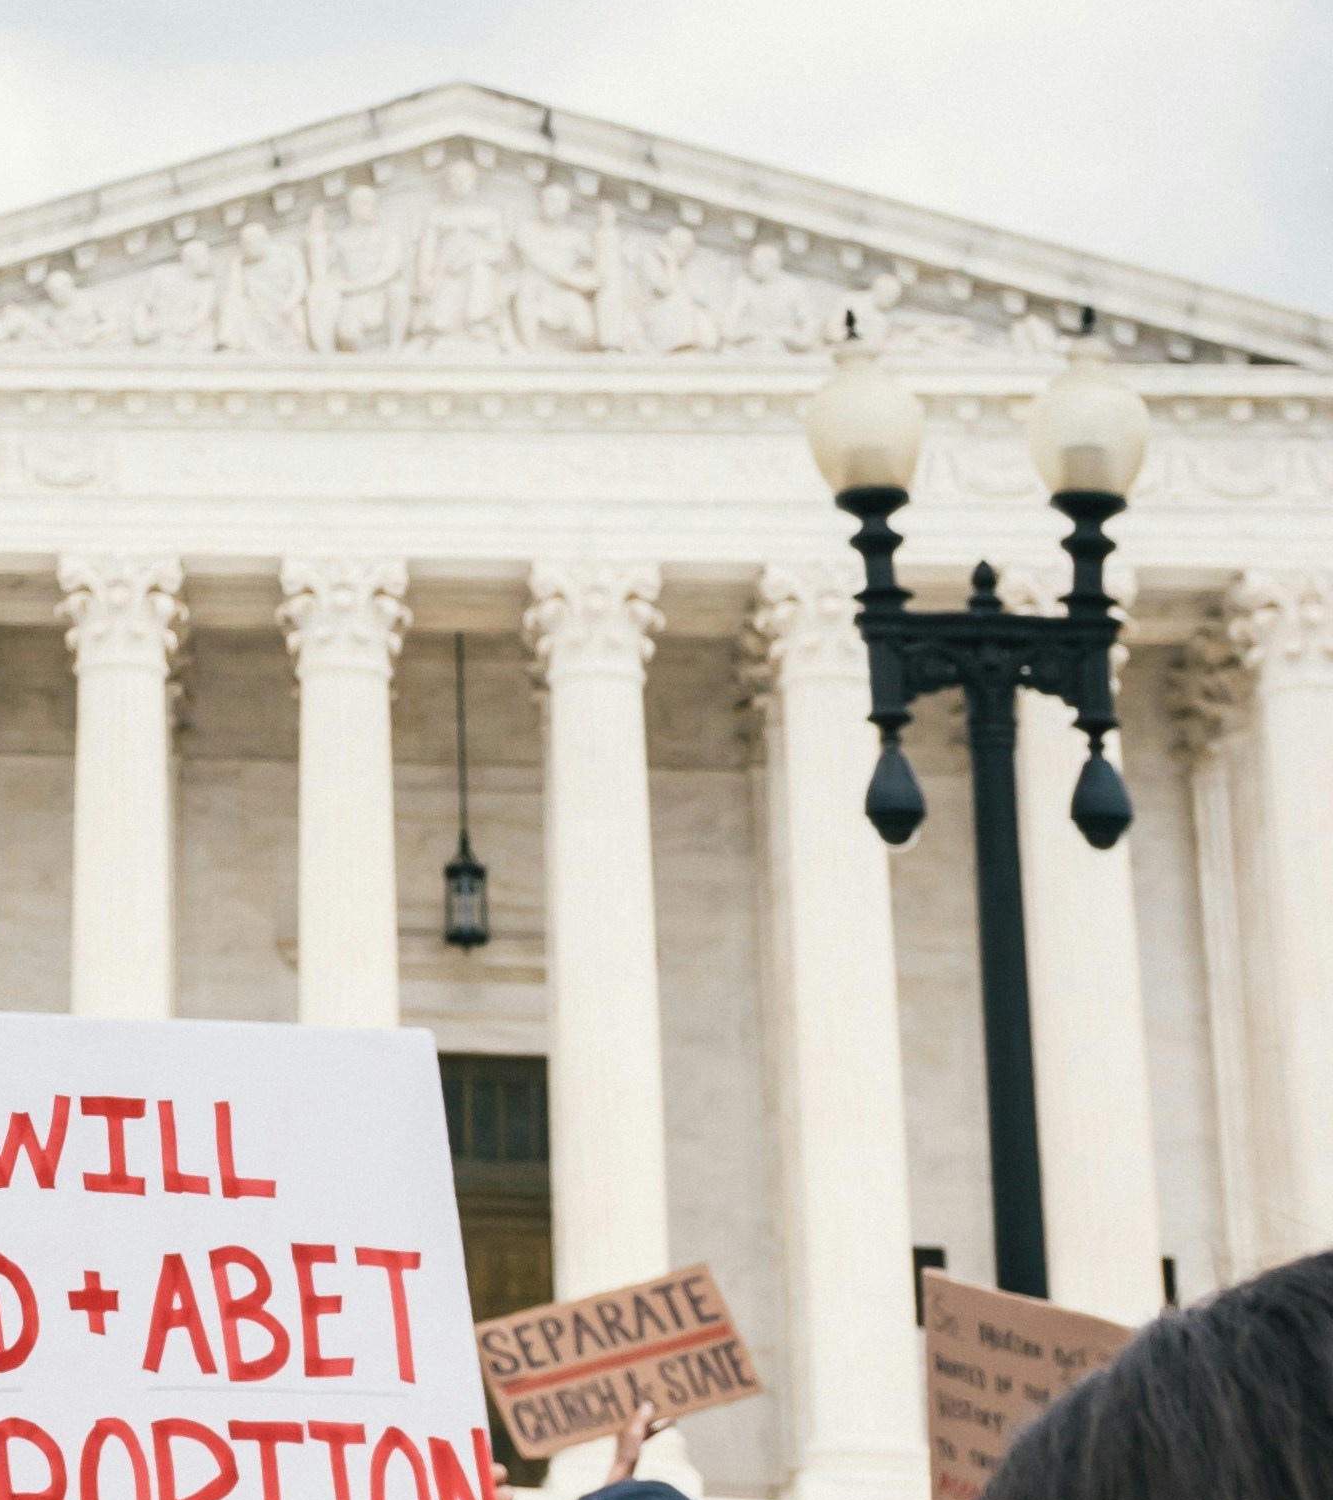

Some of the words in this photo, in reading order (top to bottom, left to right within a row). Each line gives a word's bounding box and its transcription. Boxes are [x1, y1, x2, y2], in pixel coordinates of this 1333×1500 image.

[141, 1243, 421, 1384] ABET
[483, 1275, 721, 1376] SEPARATE
[657, 1340, 756, 1405] STATE
